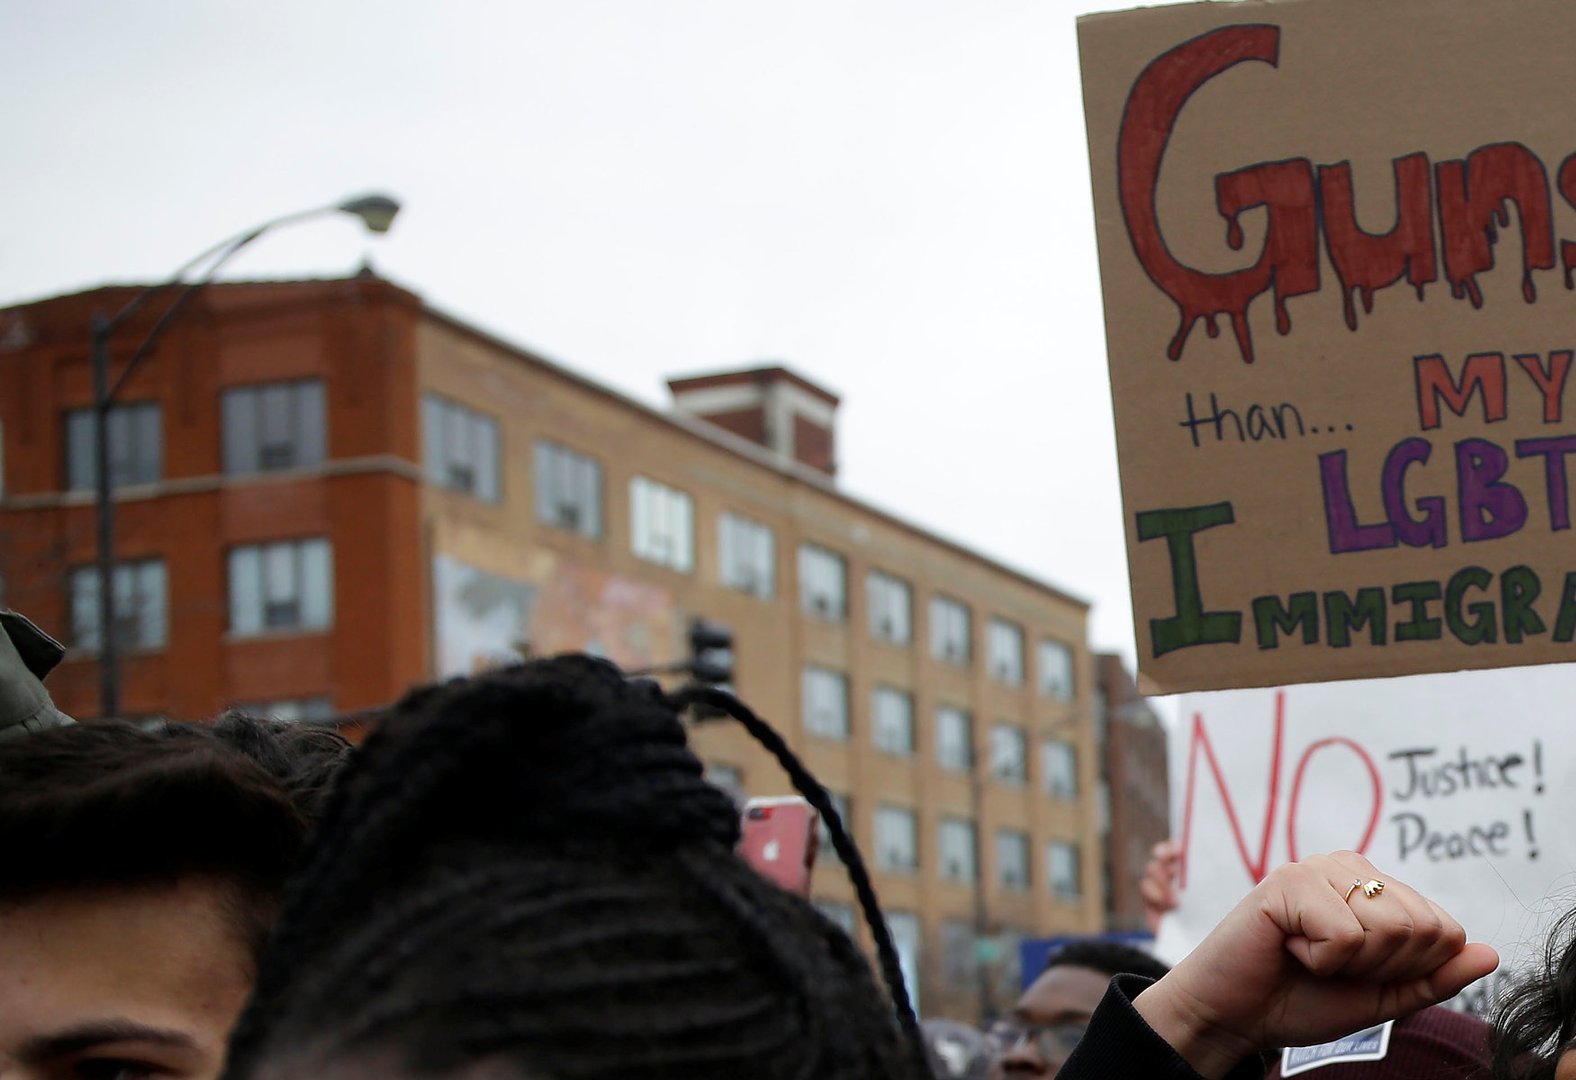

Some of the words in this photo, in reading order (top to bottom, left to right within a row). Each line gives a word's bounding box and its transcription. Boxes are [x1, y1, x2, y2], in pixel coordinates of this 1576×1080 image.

[1180, 392, 1354, 447] than...
[1413, 349, 1574, 430] MY
[1179, 691, 1382, 888] NO
[1387, 739, 1544, 799] Justice!
